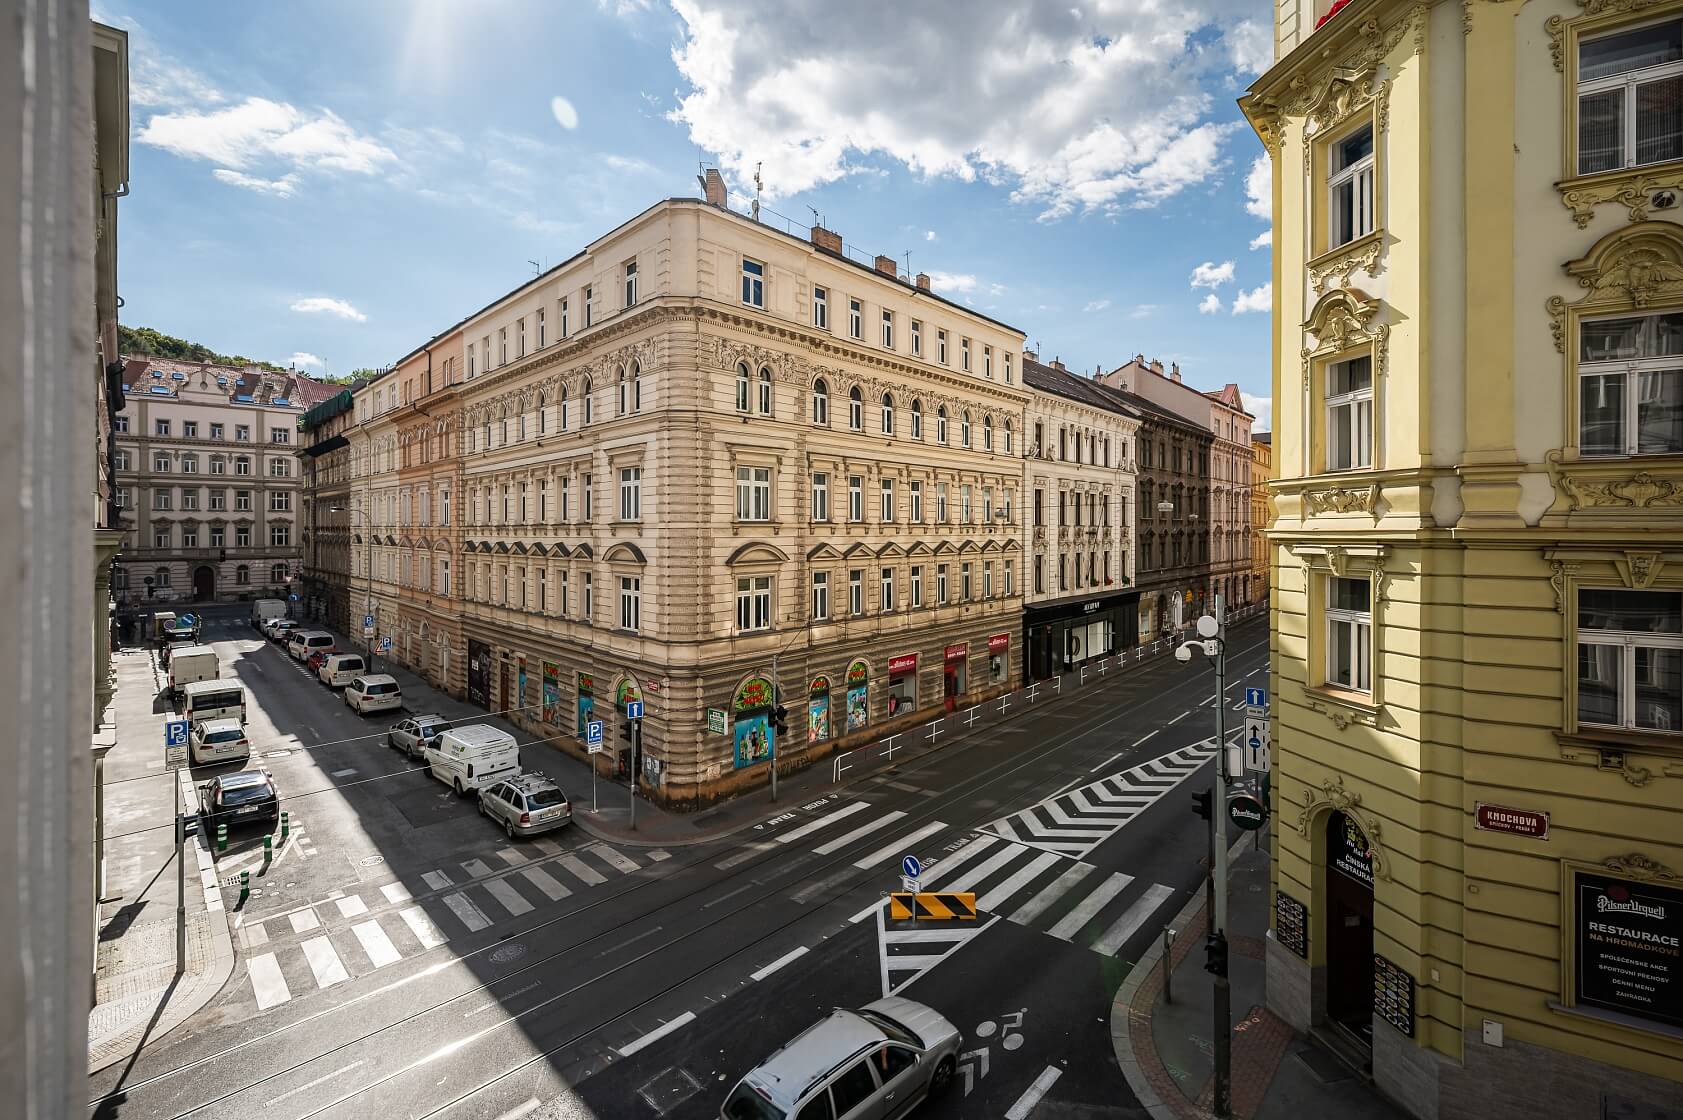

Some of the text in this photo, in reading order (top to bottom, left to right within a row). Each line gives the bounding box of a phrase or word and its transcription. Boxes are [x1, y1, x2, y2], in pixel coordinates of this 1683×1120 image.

[170, 724, 184, 739] P
[590, 724, 600, 738] P
[1487, 810, 1537, 827] KMOCHOVA
[943, 838, 971, 852] TRAM
[1336, 858, 1375, 885] RESTAURAC
[1596, 895, 1665, 919] Pilsner Urquell
[1588, 921, 1680, 947] RESTAURACE
[1589, 933, 1604, 942] NA
[1650, 964, 1670, 972] AKCE
[1634, 983, 1656, 992] MENU
